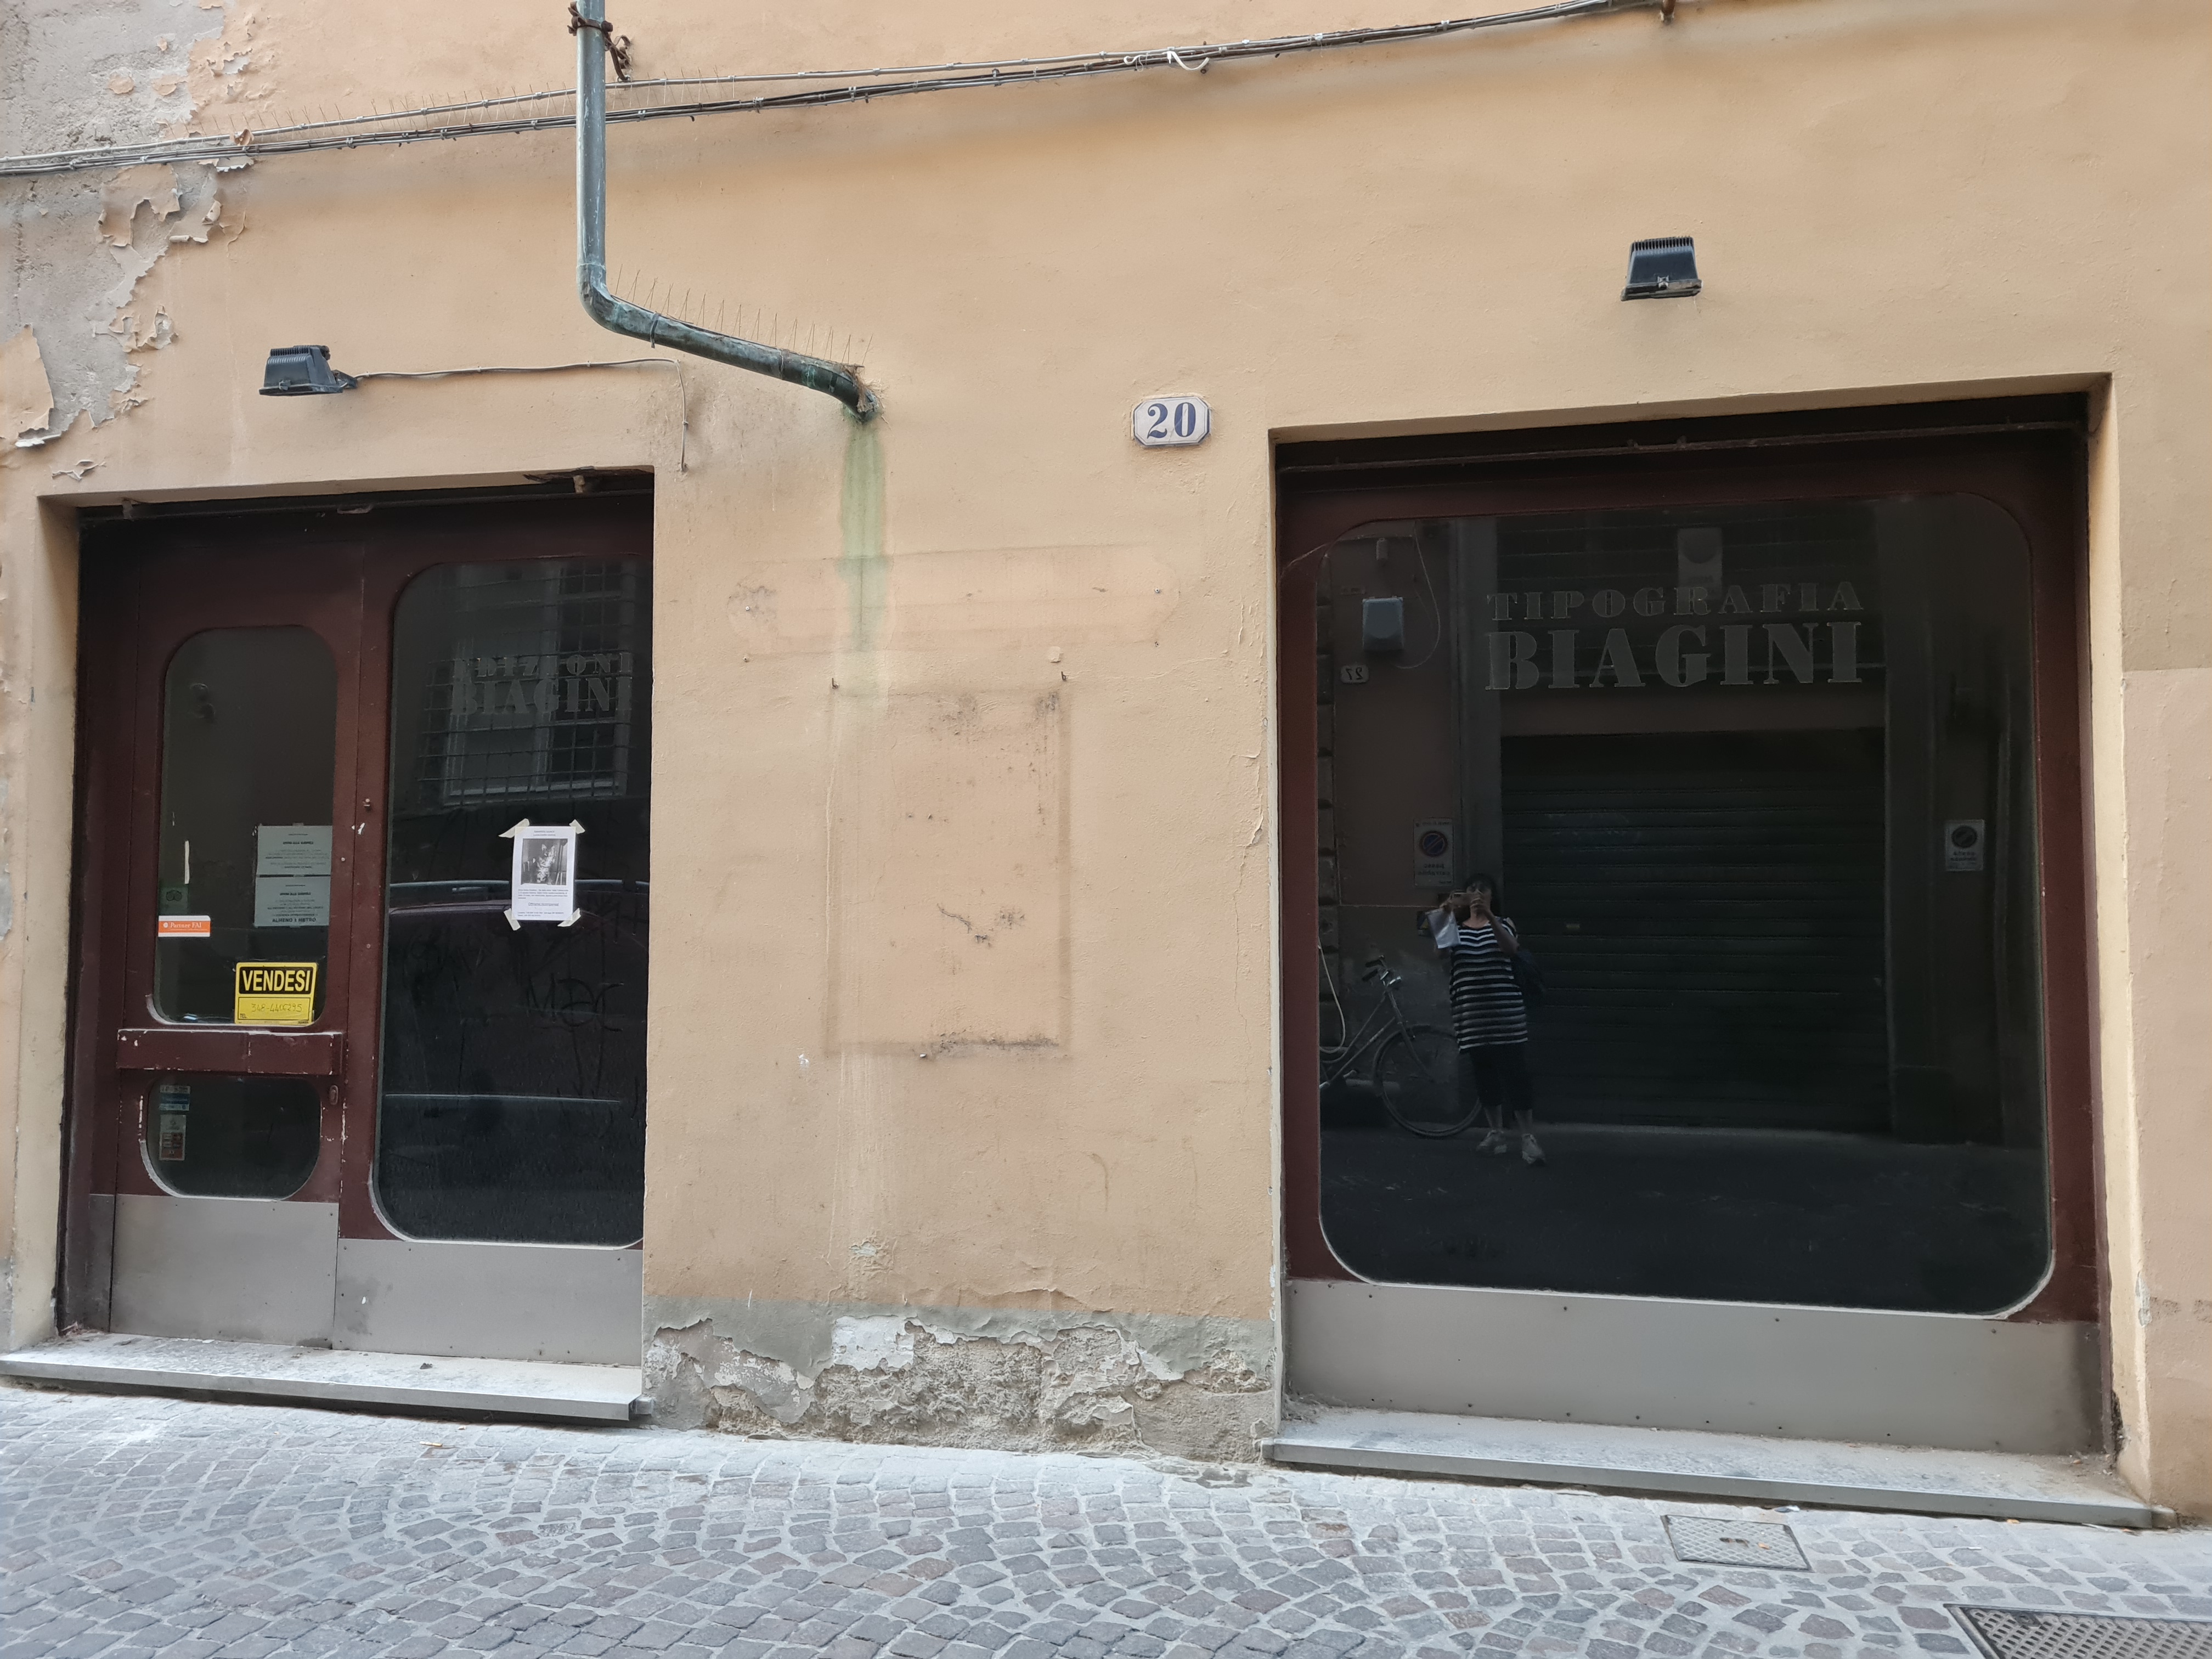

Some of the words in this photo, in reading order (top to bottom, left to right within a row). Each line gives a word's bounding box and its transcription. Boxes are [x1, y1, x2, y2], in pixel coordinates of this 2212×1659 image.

[1147, 402, 1196, 439] 20
[1486, 581, 1864, 621] TIPOGRAFIA
[1485, 622, 1862, 690] BIAGINI
[450, 676, 633, 715] BIAGINI
[242, 969, 311, 991] VENDESI
